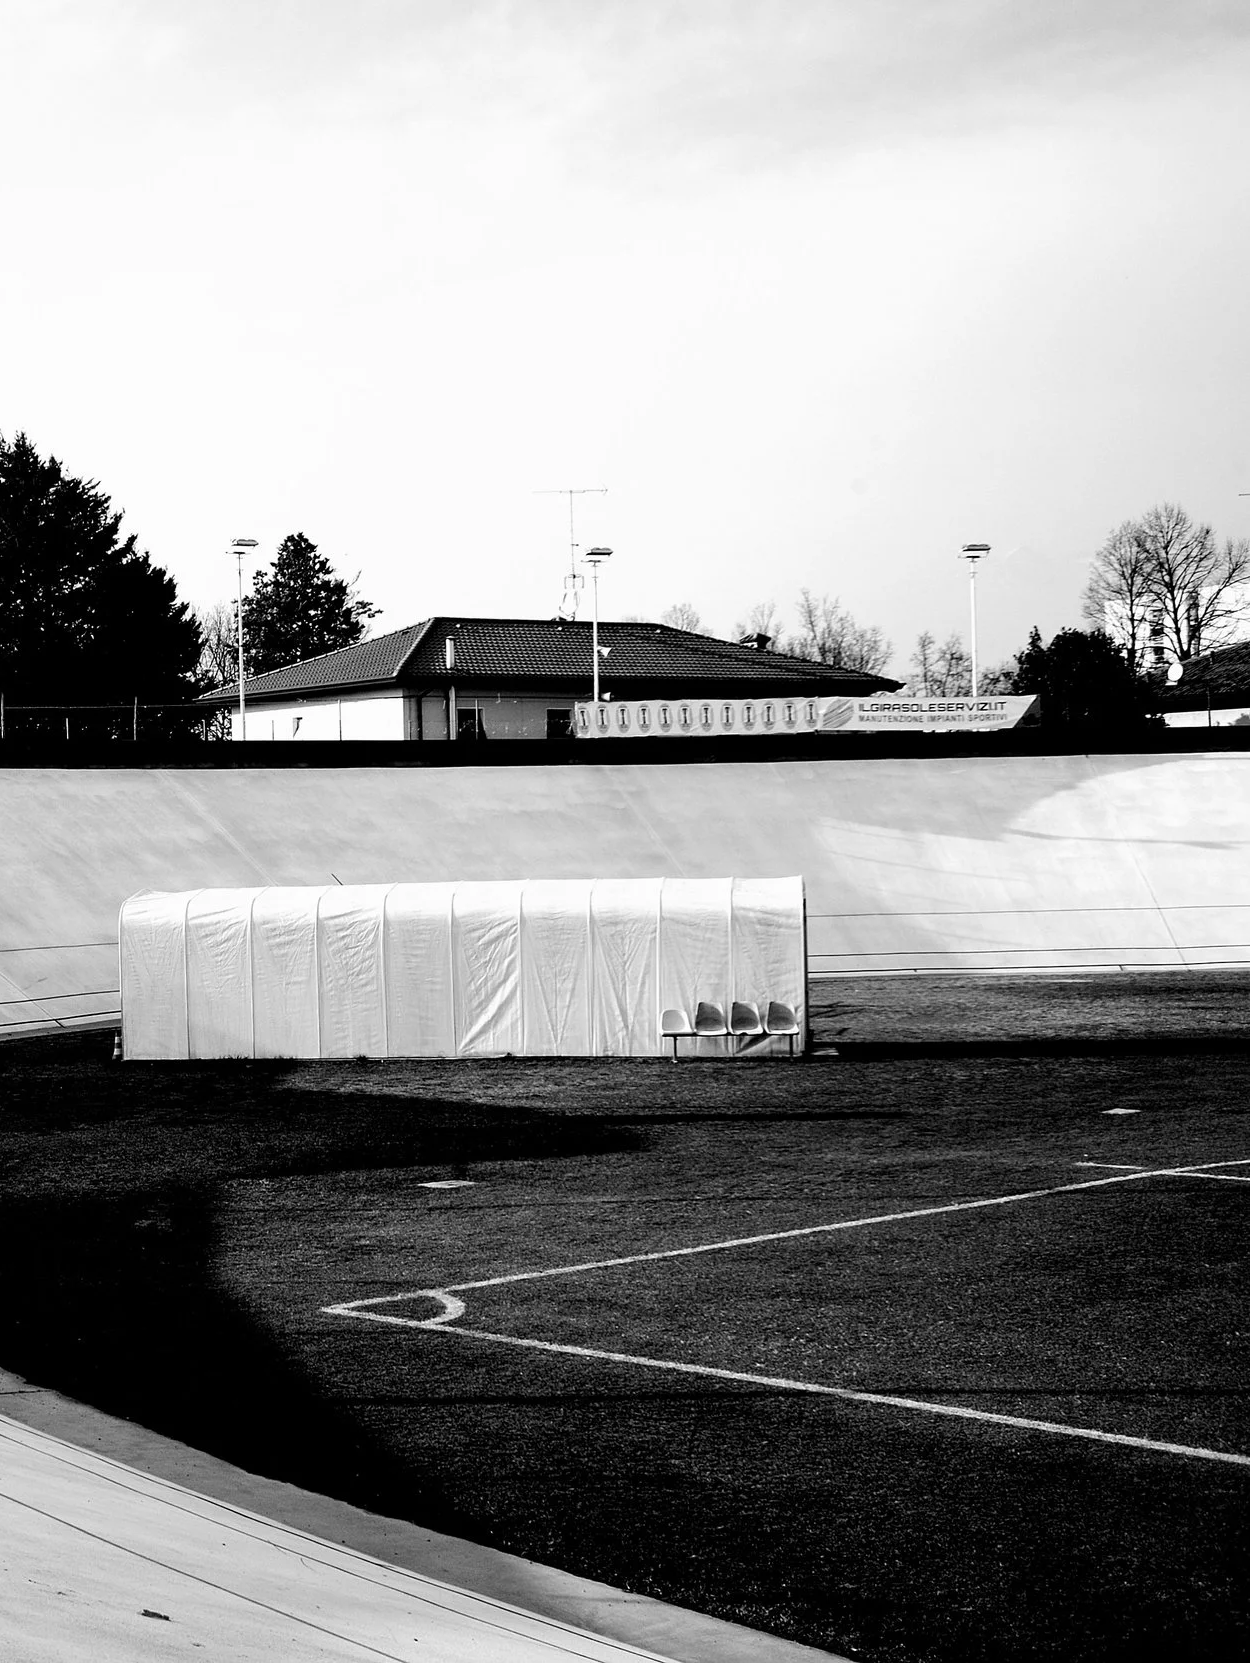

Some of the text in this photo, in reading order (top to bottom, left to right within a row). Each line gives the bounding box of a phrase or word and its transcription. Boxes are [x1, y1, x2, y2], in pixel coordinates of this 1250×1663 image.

[859, 713, 1008, 723] MANUTENZIONE IMPIANTI SPORTIVI
